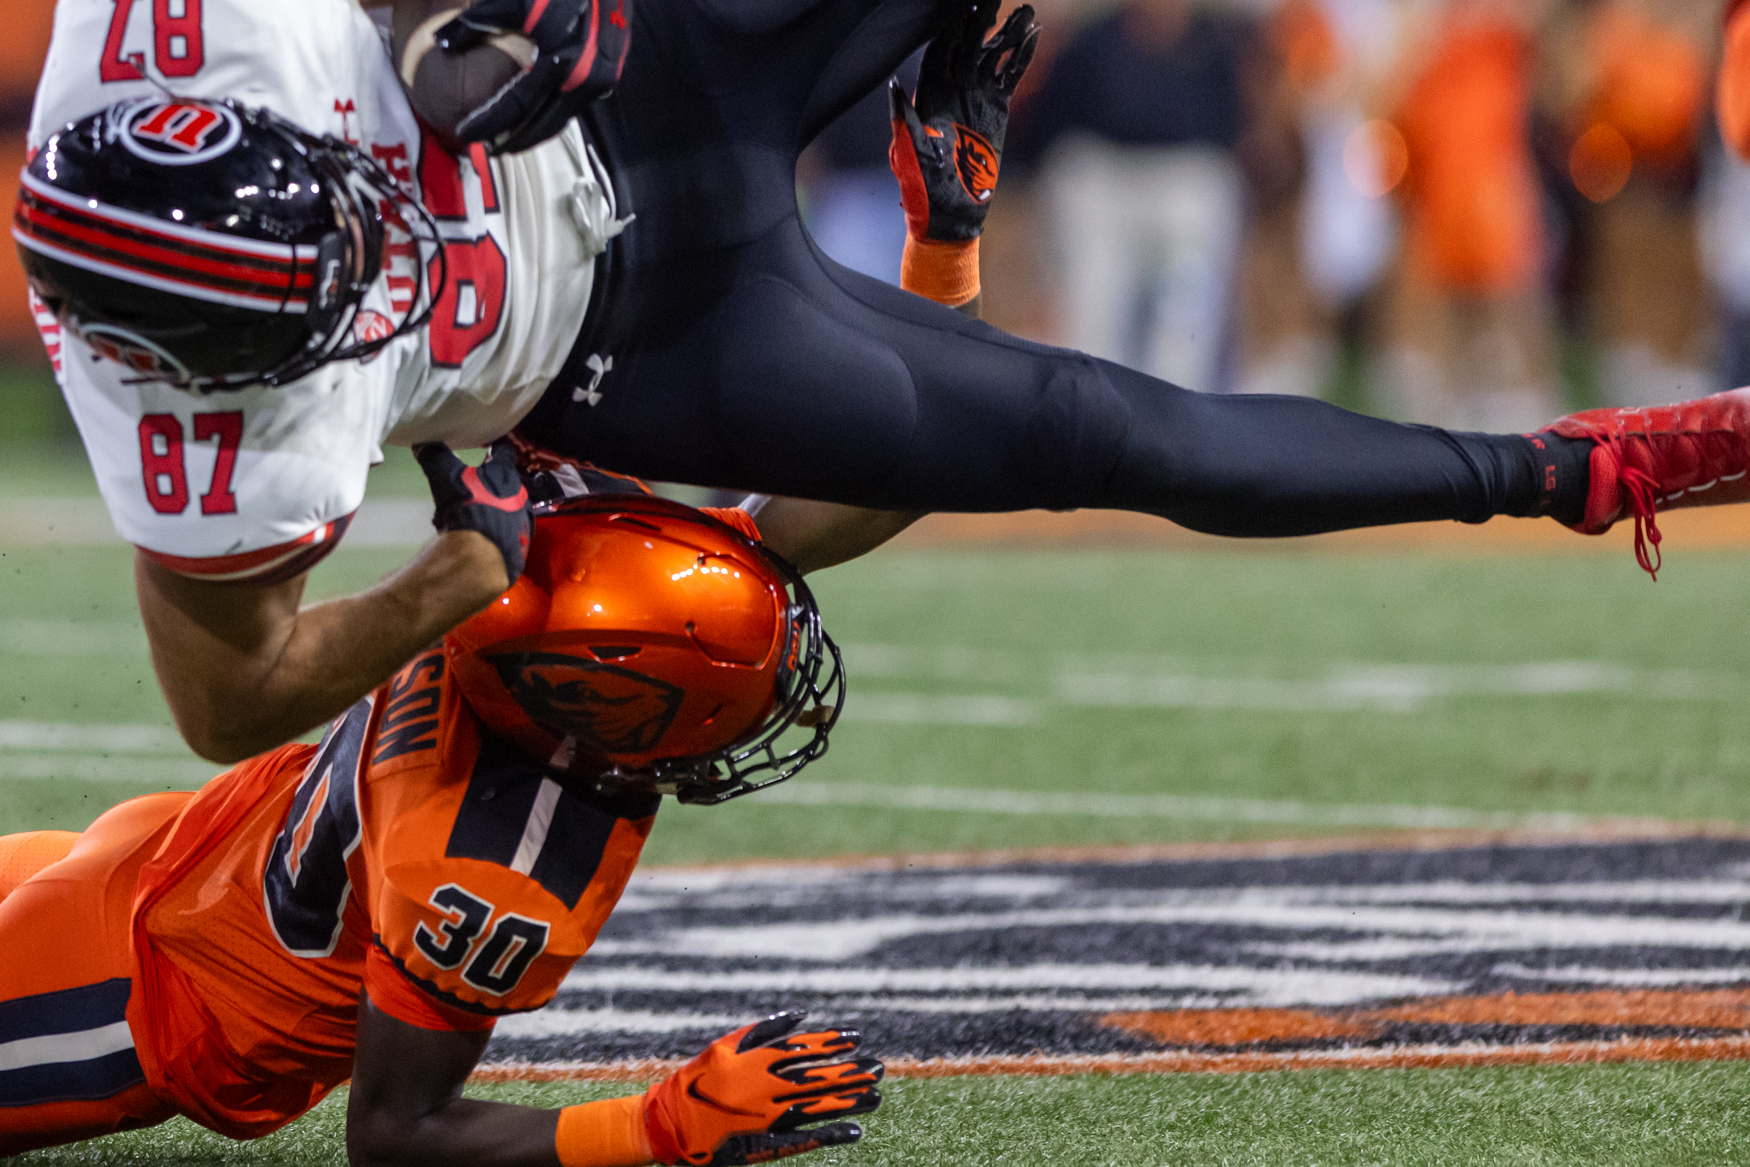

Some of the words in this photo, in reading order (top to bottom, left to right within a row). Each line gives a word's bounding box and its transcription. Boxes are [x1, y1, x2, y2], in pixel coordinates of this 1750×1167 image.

[138, 409, 244, 515] 87
[372, 653, 445, 766] SON
[413, 883, 551, 997] 30
